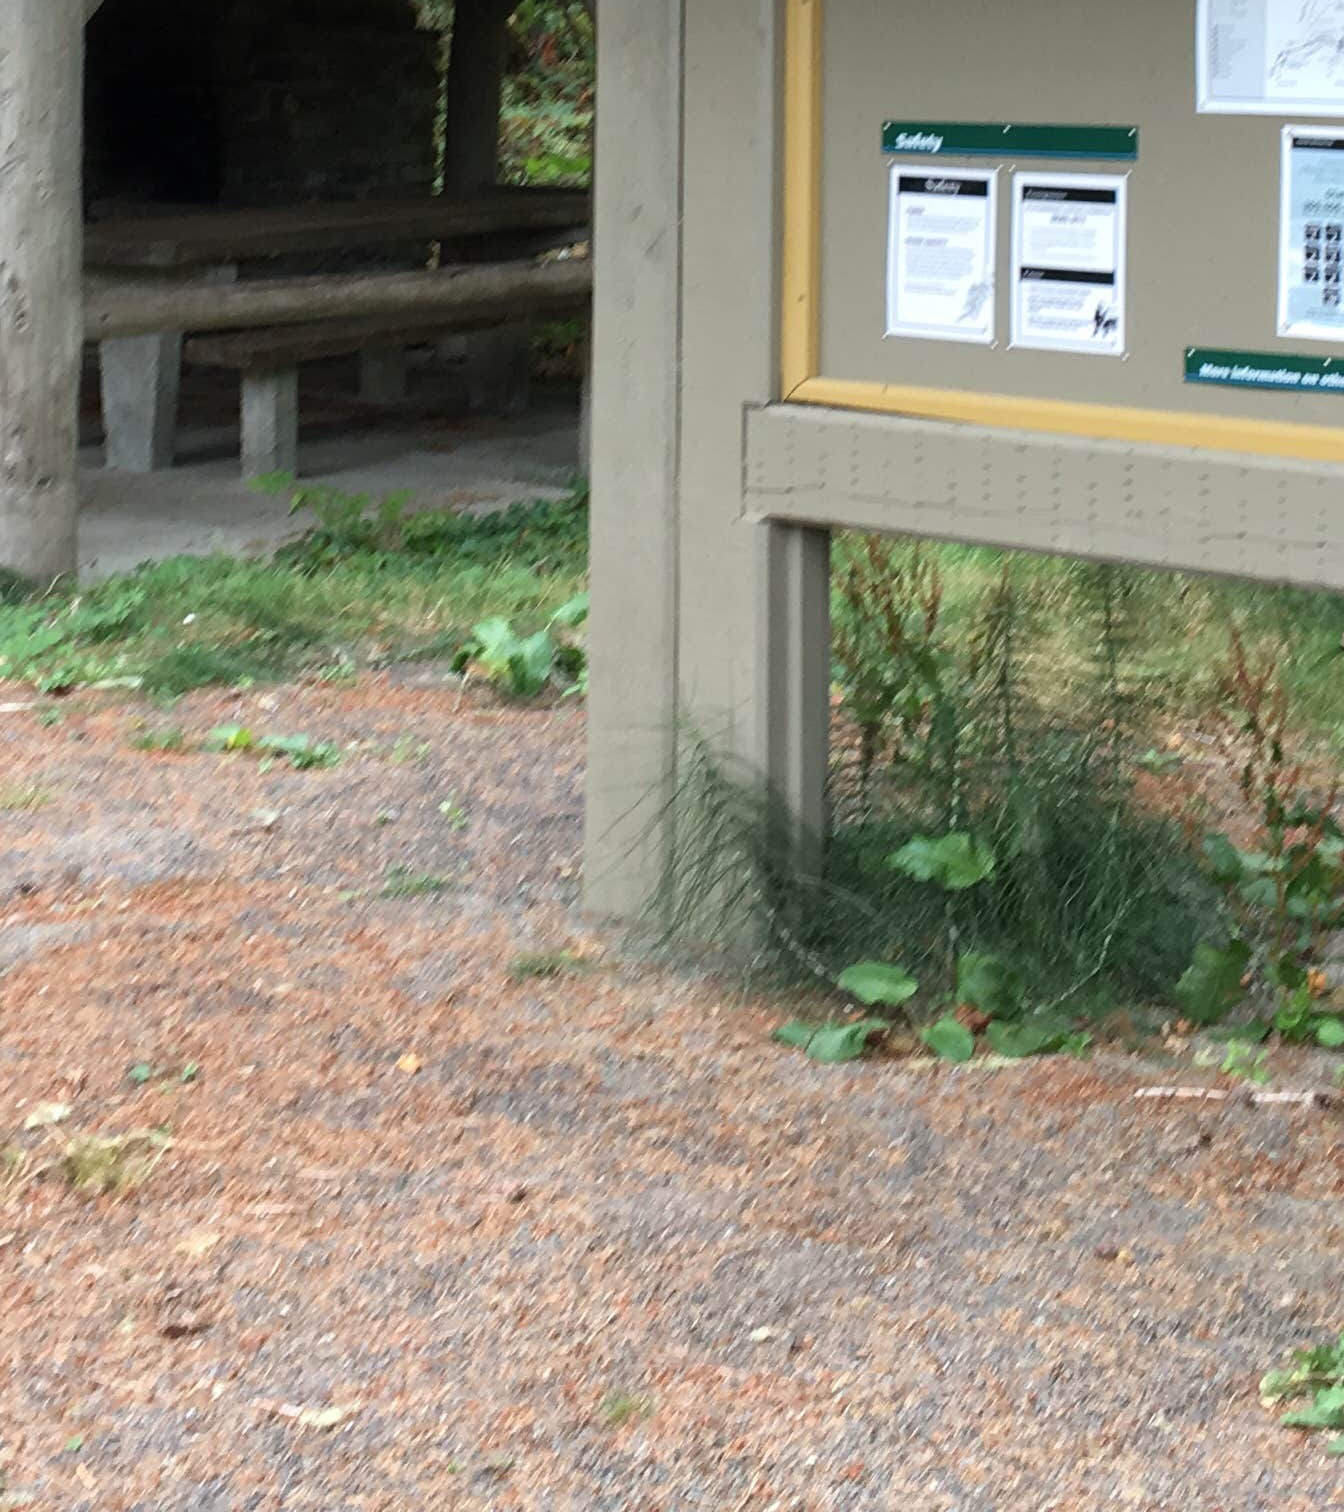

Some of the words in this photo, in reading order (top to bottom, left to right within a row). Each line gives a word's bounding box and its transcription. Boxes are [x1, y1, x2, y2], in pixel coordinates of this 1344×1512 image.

[894, 131, 943, 153] Safety
[1199, 362, 1230, 380] More
[1231, 363, 1302, 385] information
[1301, 371, 1319, 386] on
